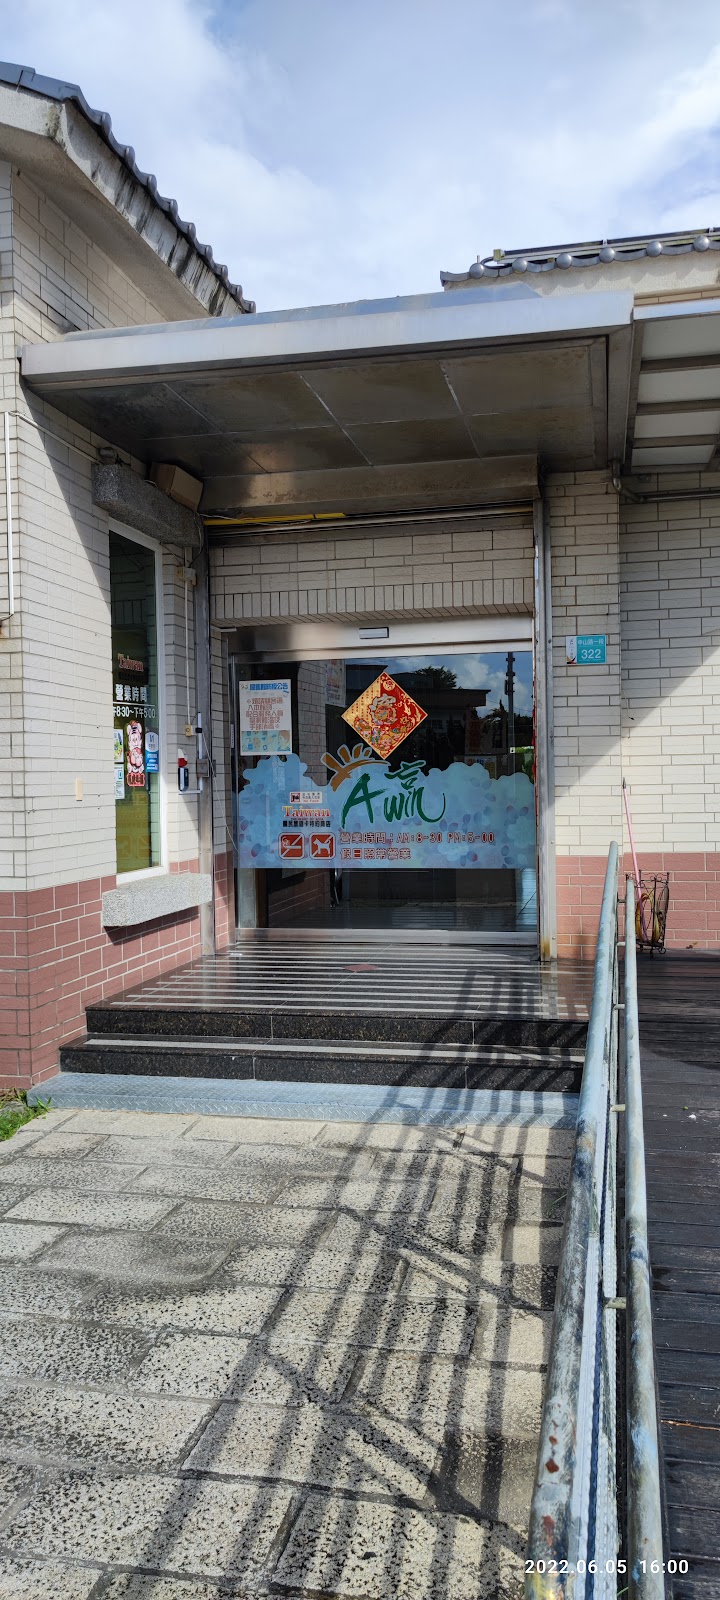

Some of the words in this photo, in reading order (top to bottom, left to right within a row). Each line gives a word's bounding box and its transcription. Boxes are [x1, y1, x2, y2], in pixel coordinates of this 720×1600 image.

[581, 648, 602, 659] 322
[115, 683, 148, 702] 營業時間
[282, 805, 331, 817] Taiwan
[340, 848, 412, 861] 假日照常營業
